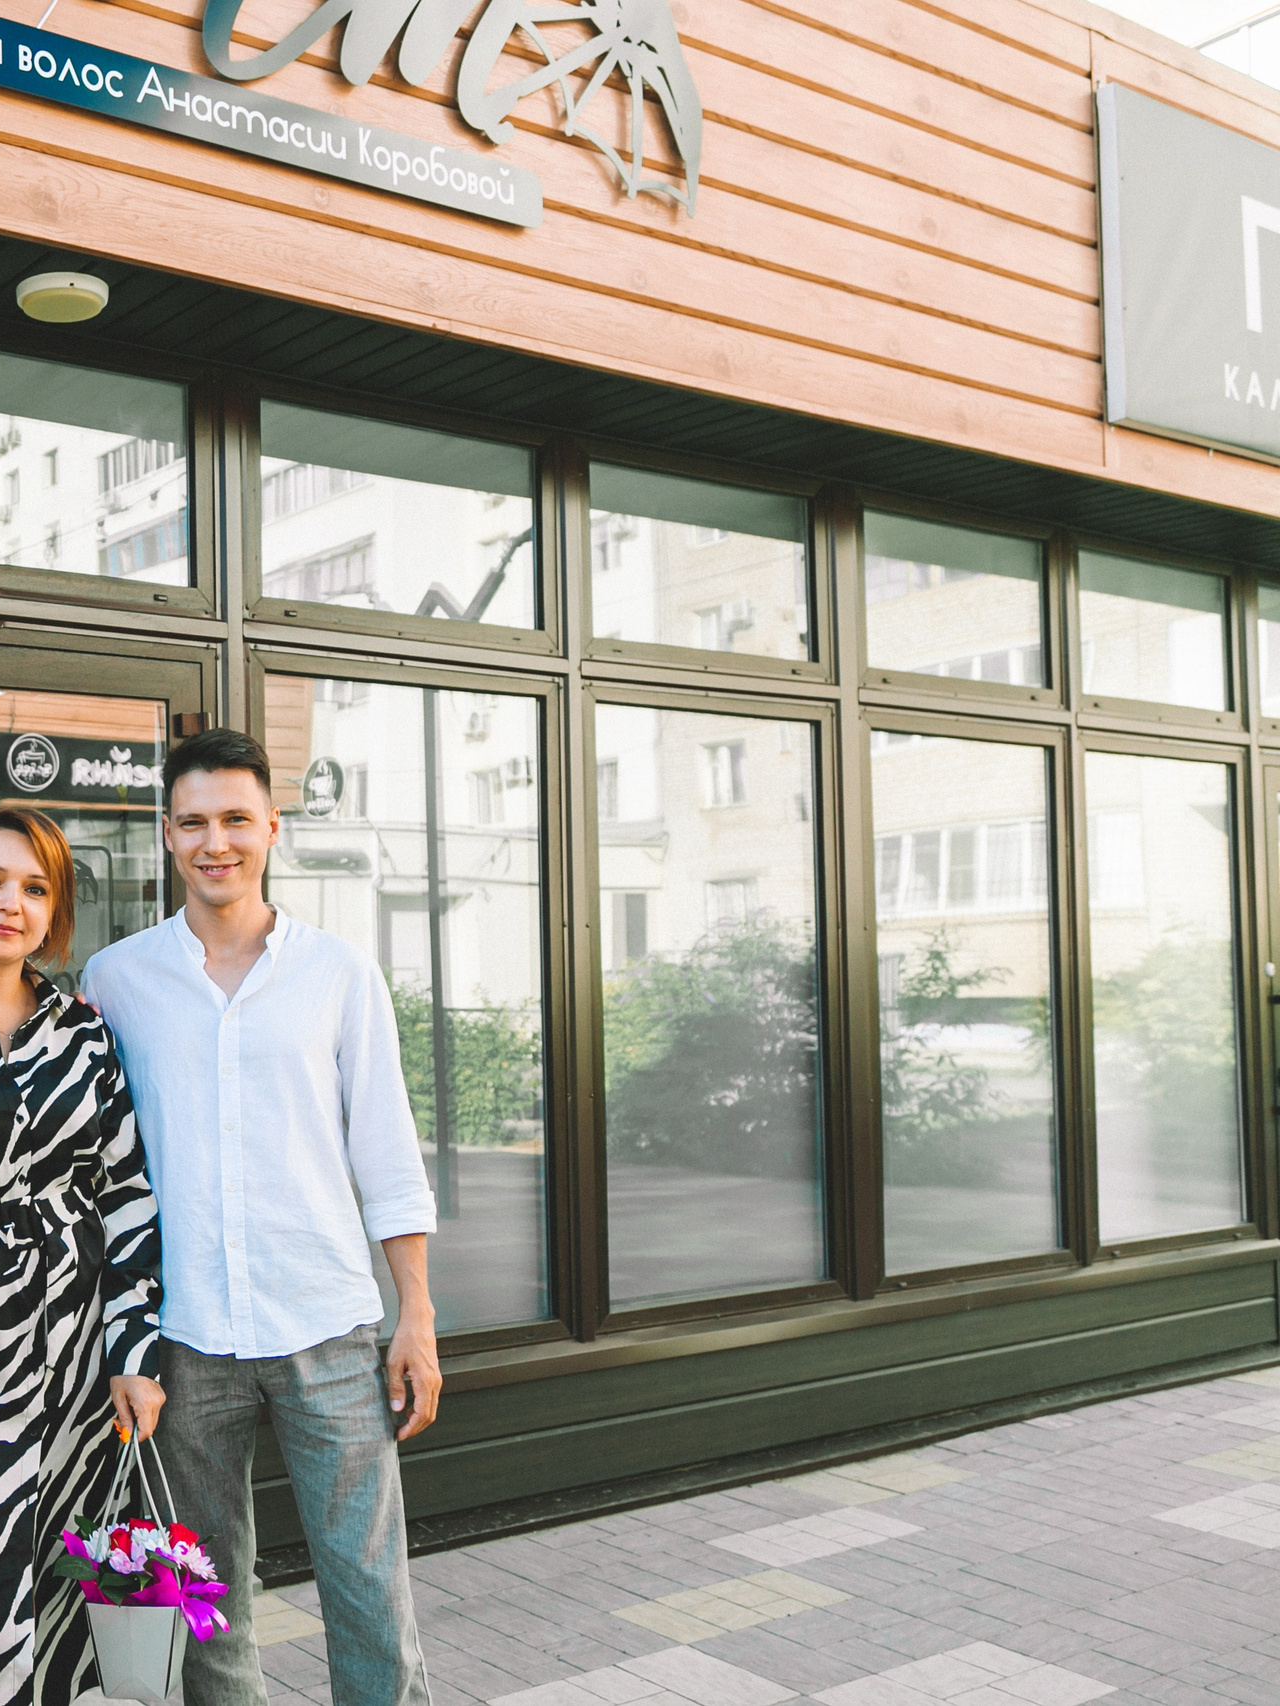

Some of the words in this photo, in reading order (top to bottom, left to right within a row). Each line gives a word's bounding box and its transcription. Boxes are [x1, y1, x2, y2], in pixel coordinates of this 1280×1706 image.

[19, 44, 124, 98] волос
[136, 66, 347, 160] Анастасии
[358, 126, 515, 206] Коробовой
